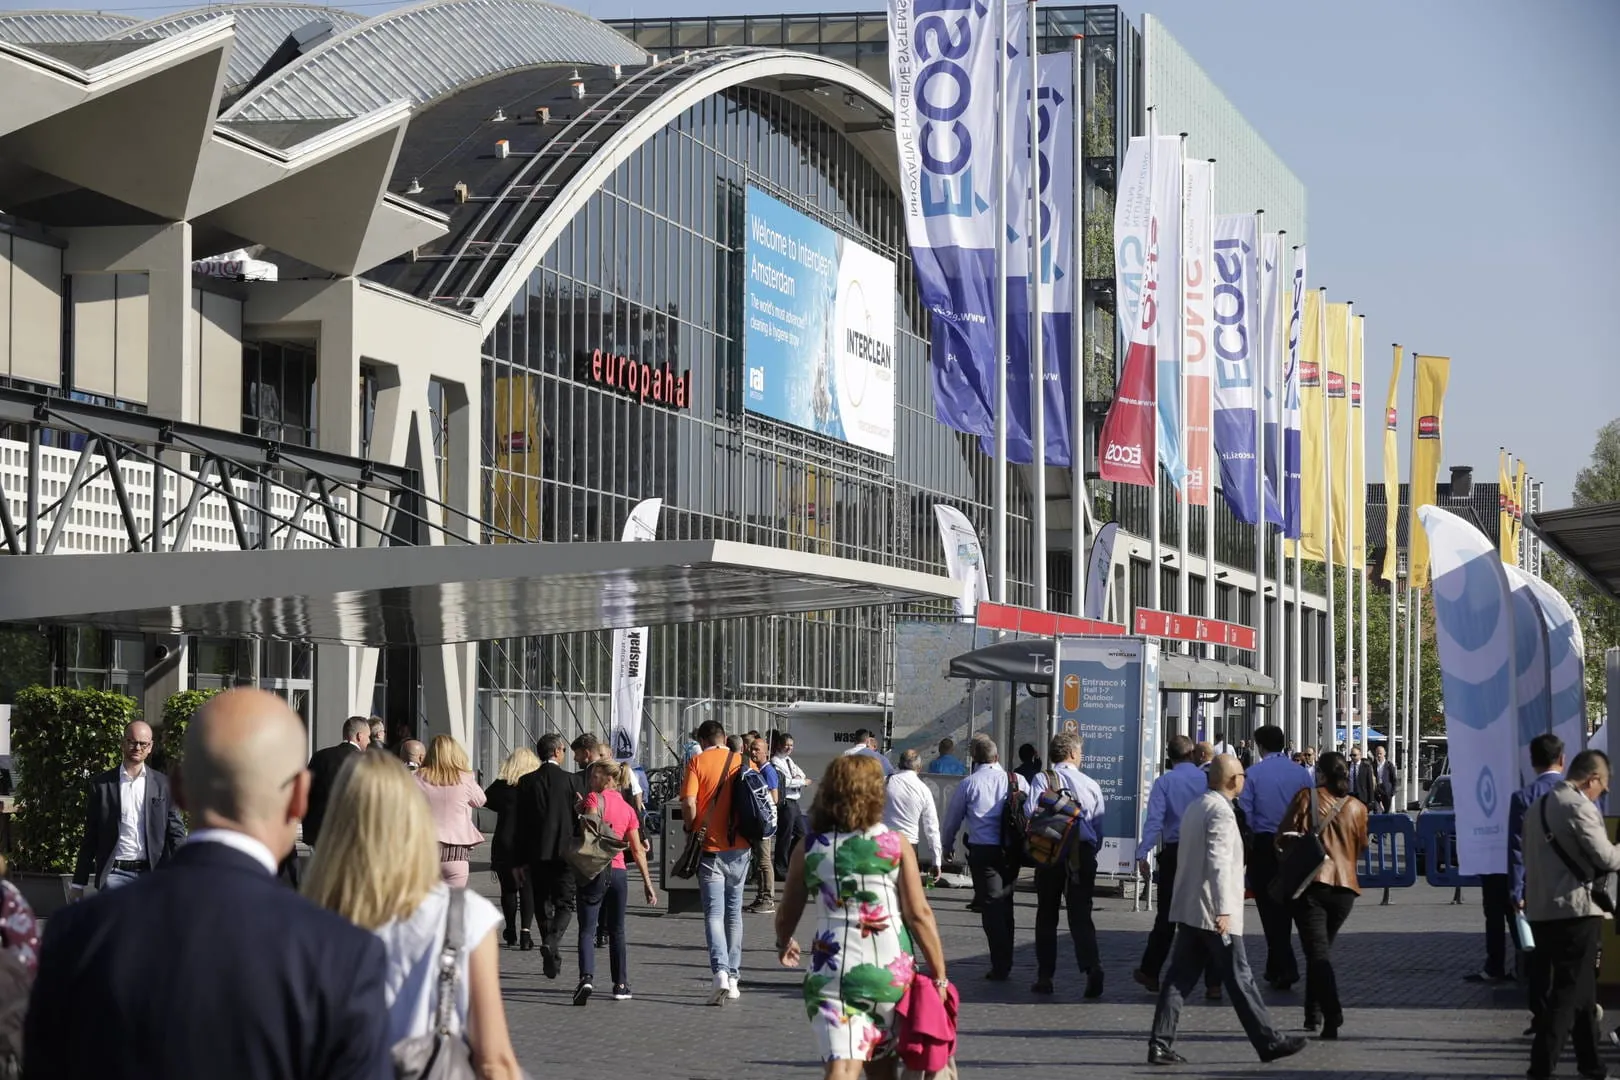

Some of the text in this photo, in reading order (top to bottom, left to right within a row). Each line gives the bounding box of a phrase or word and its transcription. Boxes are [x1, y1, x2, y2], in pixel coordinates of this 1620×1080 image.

[752, 213, 833, 275] Welcome to Interclean
[751, 253, 796, 297] Amsterdam
[750, 292, 760, 310] The
[846, 327, 891, 369] INTERCLEAN
[592, 347, 693, 409] europahal
[749, 366, 764, 393] rai
[627, 631, 641, 678] waspak
[1028, 653, 1054, 674] Ta
[1082, 678, 1119, 687] Entrance
[1083, 701, 1104, 709] demo
[834, 731, 855, 743] was
[1080, 723, 1126, 733] Entrance C
[1080, 755, 1124, 763] Entrance F
